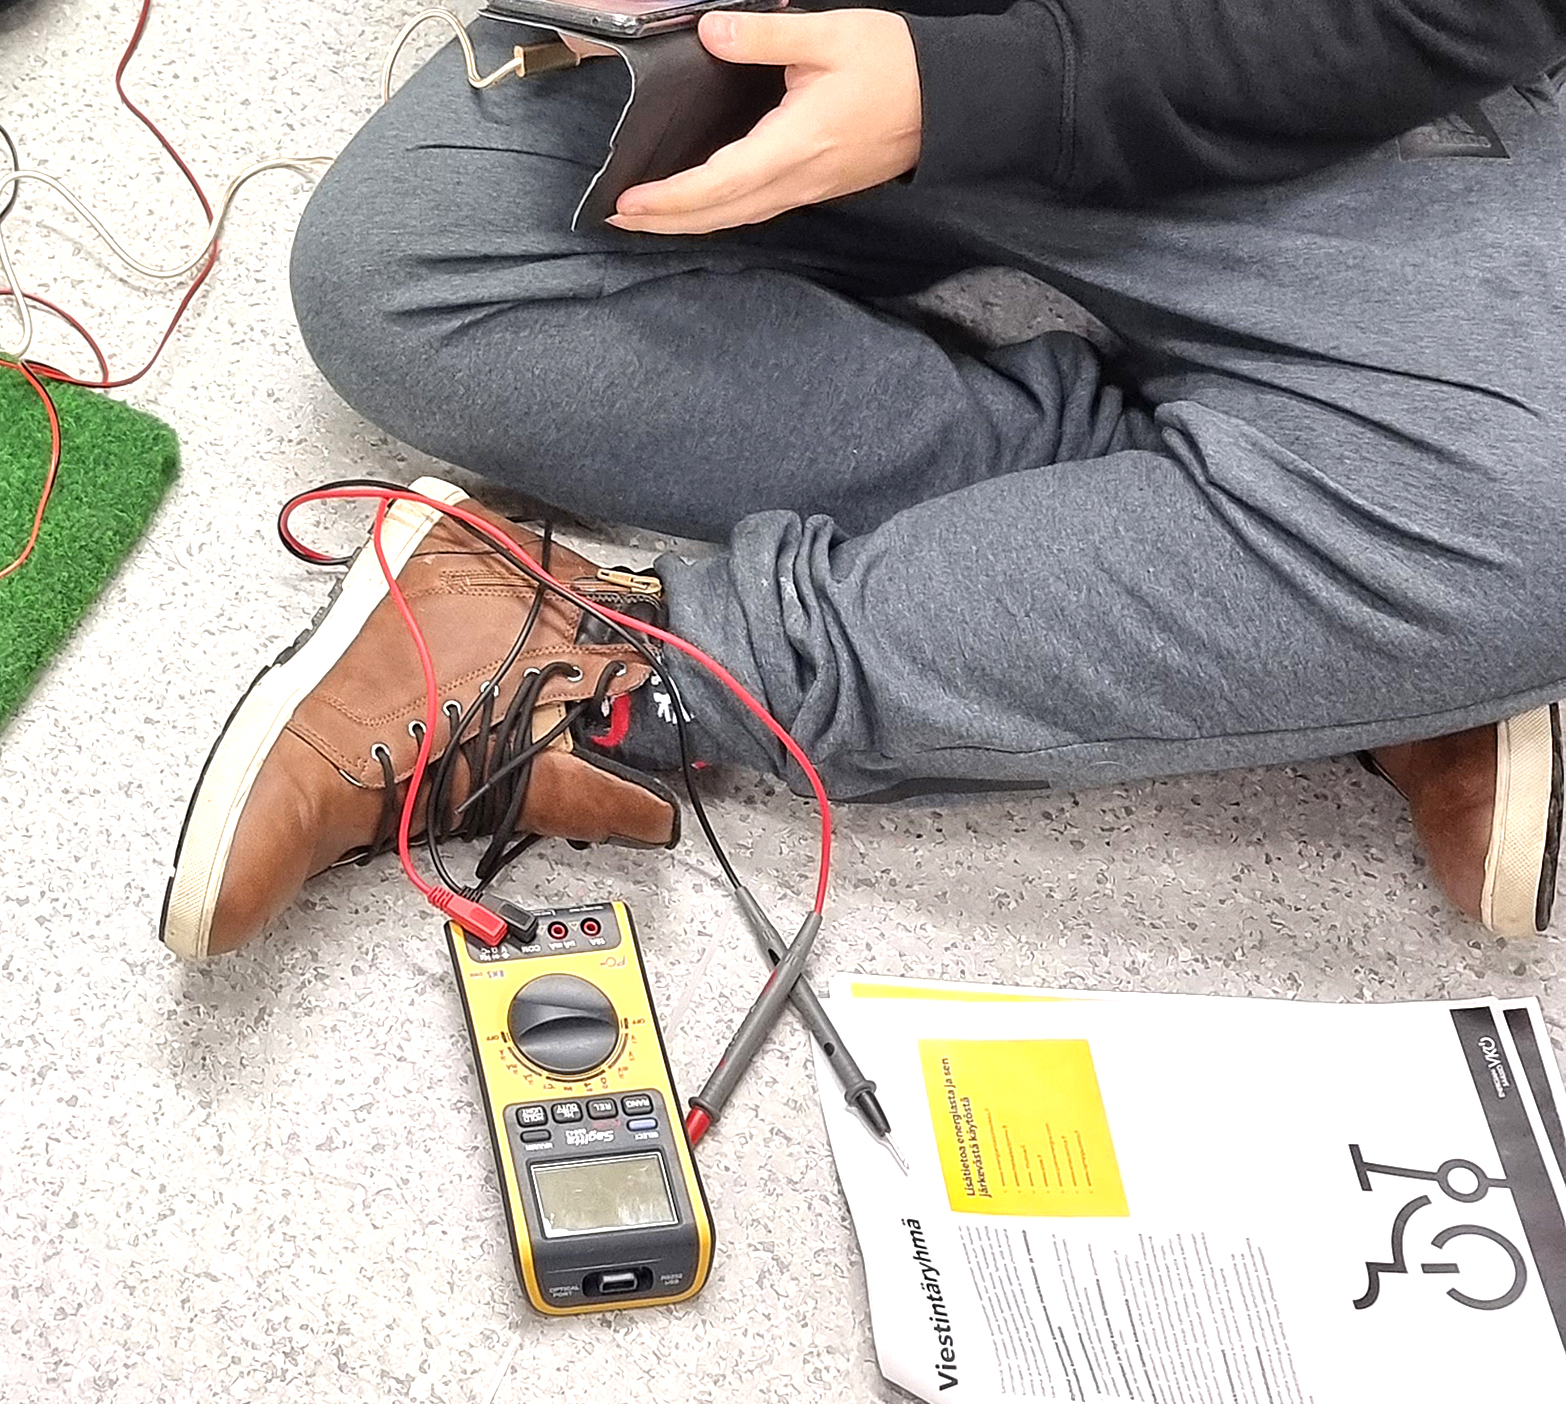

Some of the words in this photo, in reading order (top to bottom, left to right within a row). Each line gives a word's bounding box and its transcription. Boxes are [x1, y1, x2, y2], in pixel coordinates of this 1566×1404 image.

[942, 1058, 951, 1076] sen
[943, 1077, 956, 1088] ja
[593, 1102, 612, 1112] REL
[947, 1089, 965, 1143] energiasta
[960, 1097, 977, 1142] käytöstä
[959, 1140, 976, 1196] Lisätietoa
[972, 1143, 992, 1198] järkevästä
[902, 1218, 959, 1392] Viestintäryhmä
